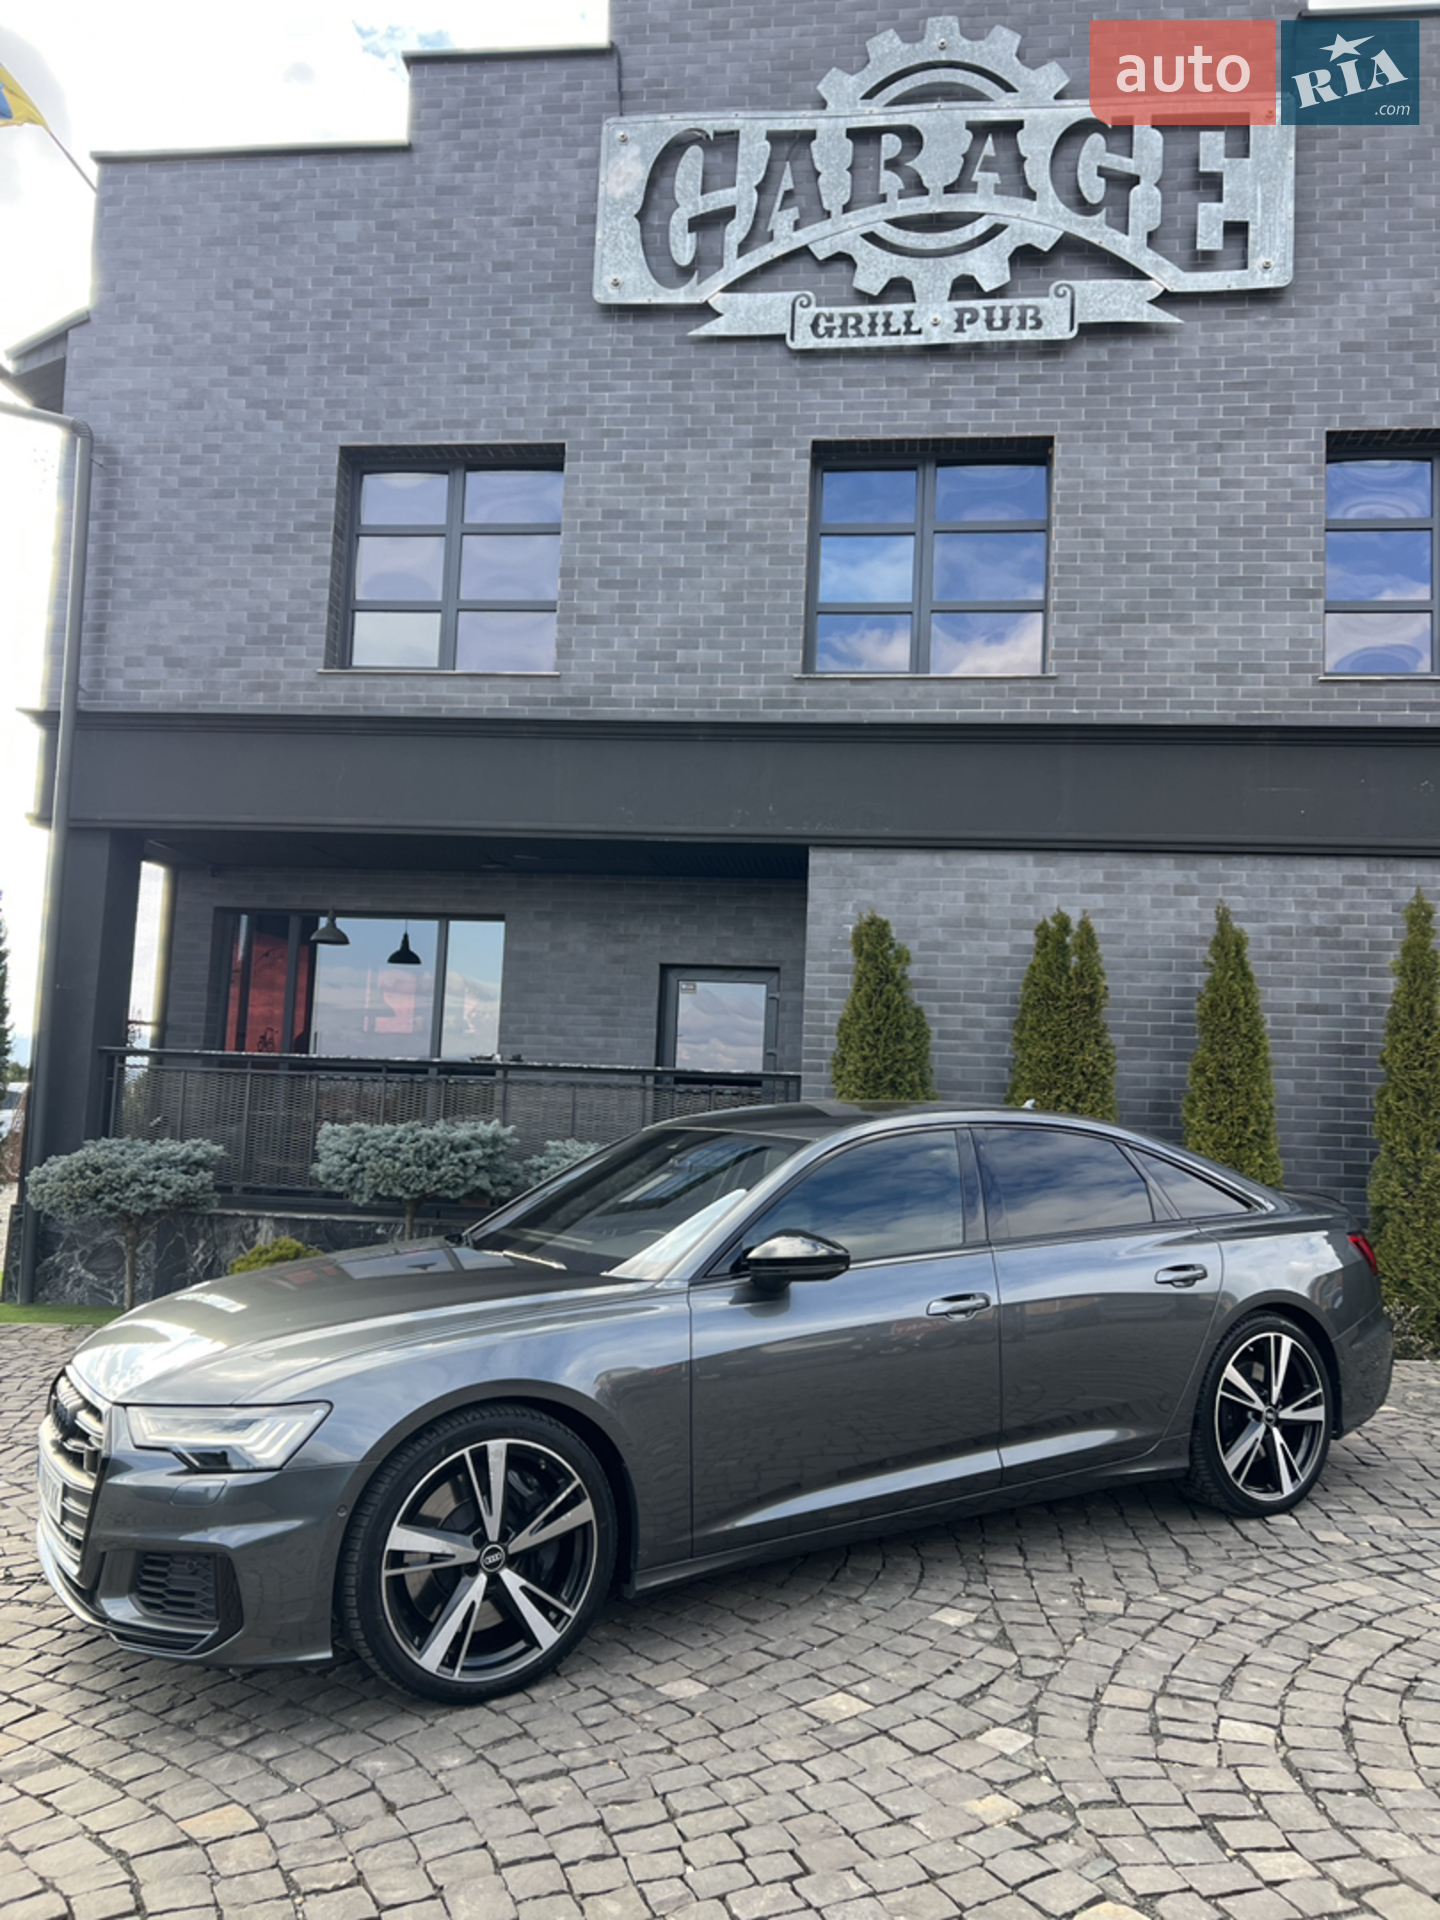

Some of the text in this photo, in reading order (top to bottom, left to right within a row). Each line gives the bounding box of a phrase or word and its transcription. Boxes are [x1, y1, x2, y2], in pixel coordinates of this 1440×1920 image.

[634, 112, 1250, 290] GARAGE
[810, 305, 1044, 338] GRILL PUB
